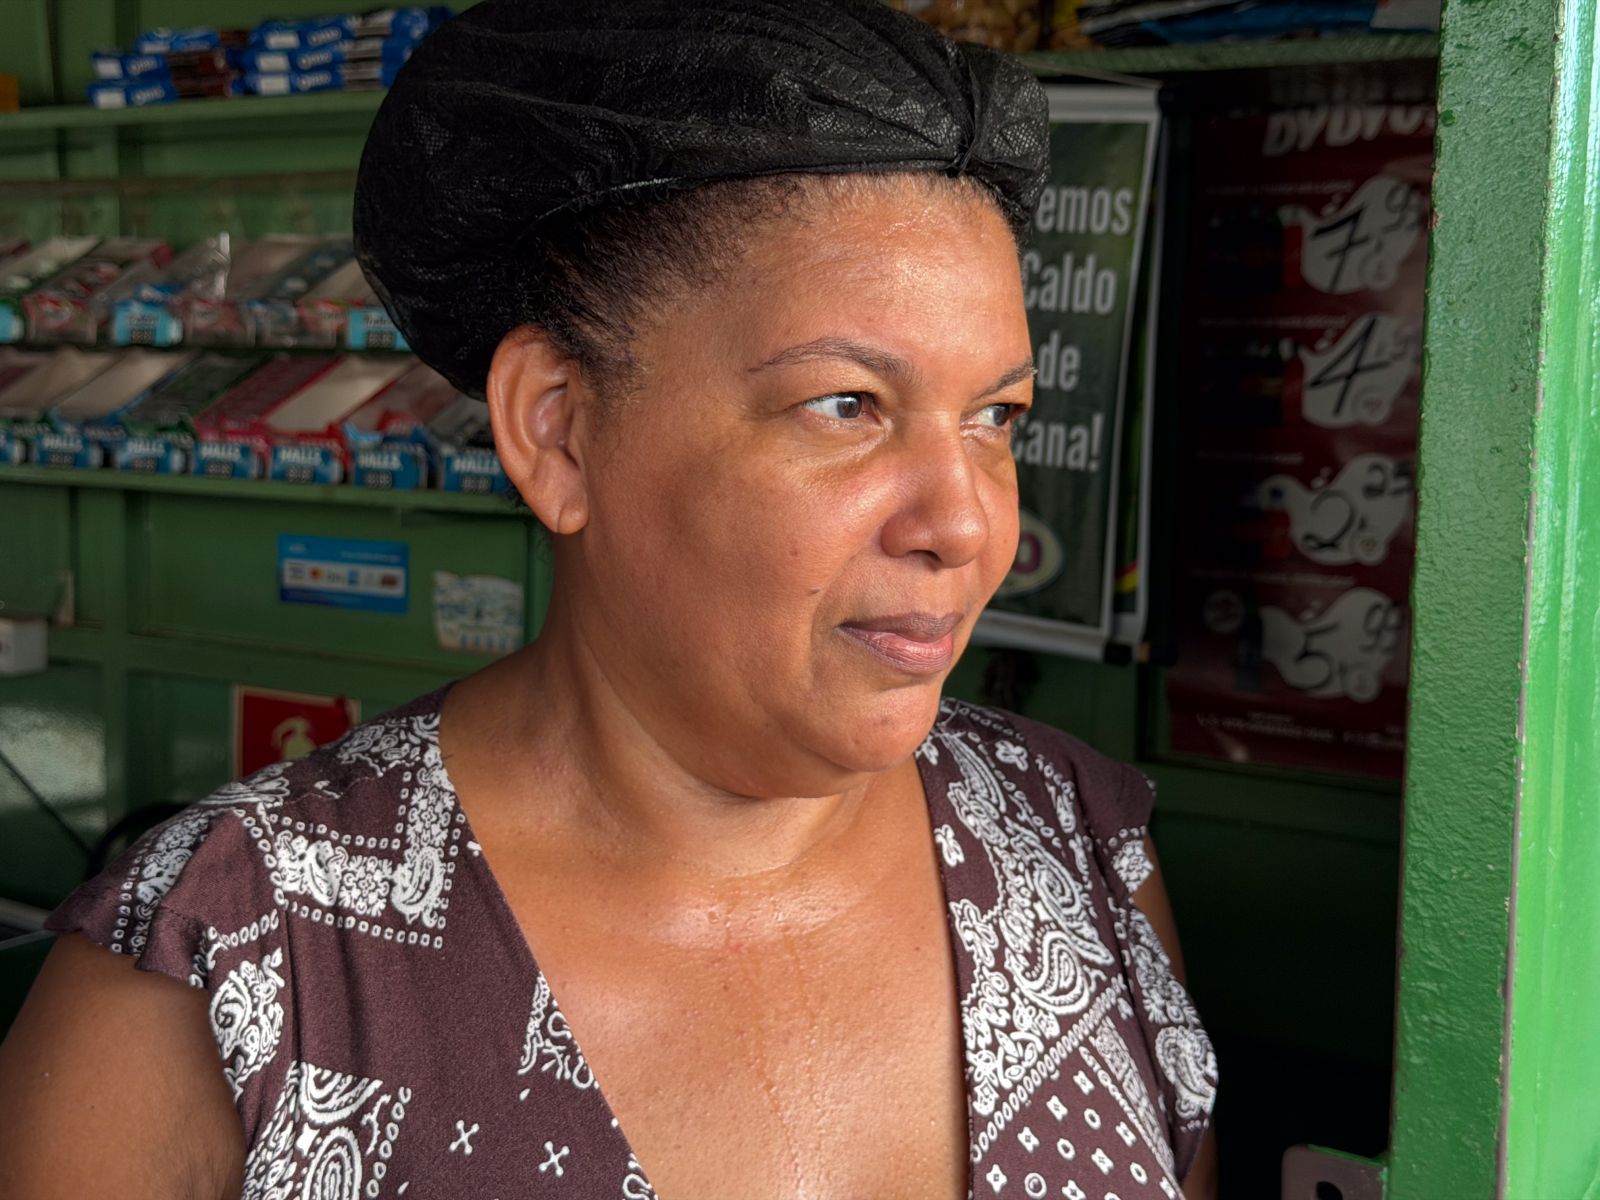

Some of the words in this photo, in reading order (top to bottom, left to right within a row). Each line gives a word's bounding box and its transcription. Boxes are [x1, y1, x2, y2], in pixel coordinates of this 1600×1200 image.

[1035, 185, 1133, 236] emos
[1022, 252, 1117, 316] Caldo
[1037, 331, 1082, 391] de
